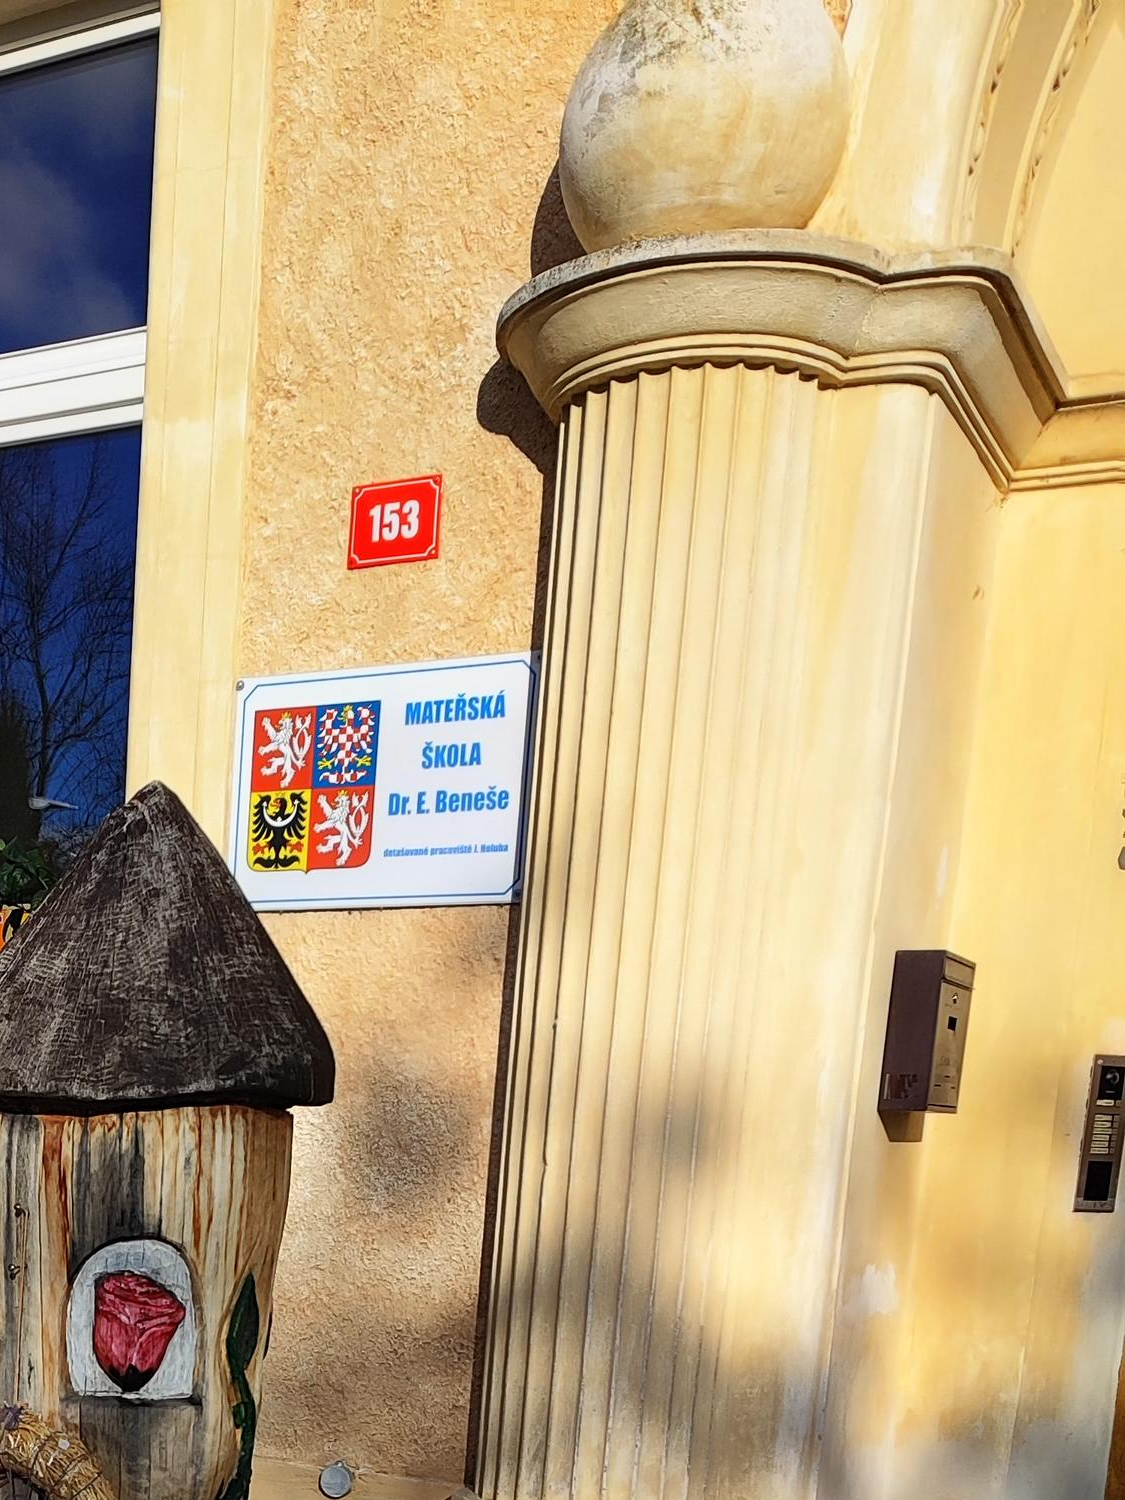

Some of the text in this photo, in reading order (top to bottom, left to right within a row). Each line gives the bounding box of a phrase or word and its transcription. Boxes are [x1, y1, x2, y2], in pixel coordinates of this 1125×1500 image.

[369, 500, 420, 543] 153
[405, 690, 506, 725] MATEŘSKÁ
[422, 741, 482, 769] ŠKOLA
[388, 786, 509, 816] Dr. E. Beneše
